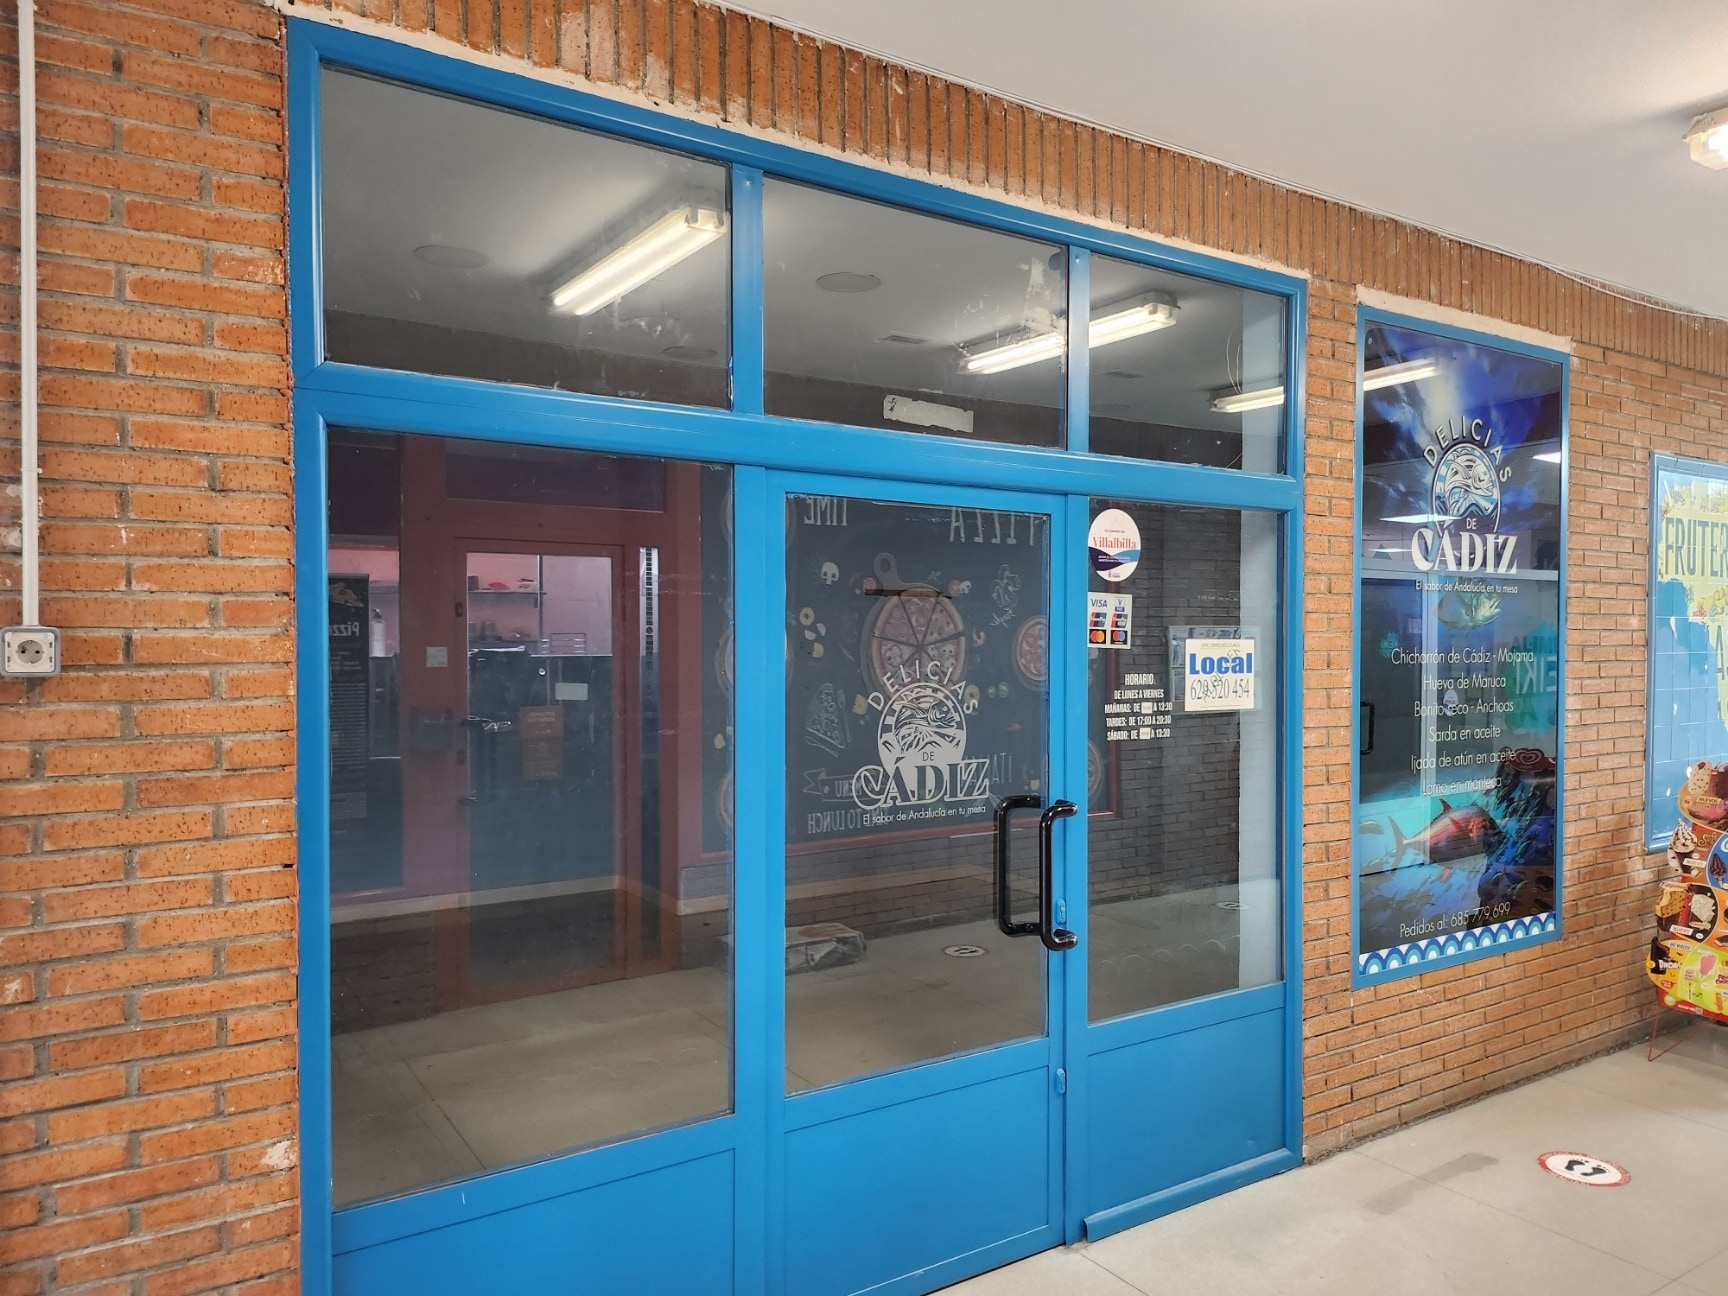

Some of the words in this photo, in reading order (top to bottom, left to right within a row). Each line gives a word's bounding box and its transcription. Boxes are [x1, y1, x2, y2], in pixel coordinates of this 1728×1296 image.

[1423, 415, 1512, 483] DELICIAS
[1466, 517, 1477, 530] DE
[1092, 536, 1137, 549] Villalbilla
[1411, 520, 1518, 575] CÁDIZ
[1424, 580, 1442, 591] sabor
[1444, 580, 1453, 591] de
[1454, 580, 1486, 592] Andalucía
[1486, 585, 1495, 593] en
[1502, 585, 1518, 593] mesa
[1090, 598, 1108, 608] VISA
[1188, 652, 1253, 675] Local
[1447, 649, 1460, 664] de
[1462, 647, 1491, 664] Cádiz
[1497, 648, 1534, 668] Mojama
[866, 659, 980, 715] DELICIAS
[1124, 673, 1154, 686] HORARIO
[1232, 678, 1250, 699] 454
[1423, 676, 1454, 690] Hueva
[1457, 673, 1469, 688] de
[1471, 675, 1506, 690] Maruca
[1133, 702, 1141, 713] DE
[1153, 702, 1158, 712] A
[1414, 700, 1444, 717] Bonito
[1476, 698, 1514, 714] Anchoas
[1128, 716, 1136, 726] DE
[1152, 715, 1156, 725] A
[1130, 729, 1138, 740] DE
[1151, 728, 1155, 739] A
[1428, 724, 1456, 743] Sarda
[1459, 730, 1471, 740] en
[1473, 726, 1501, 740] aceite
[922, 751, 935, 763] DE
[1438, 751, 1451, 767] de
[1454, 751, 1473, 766] atún
[1476, 753, 1487, 764] en
[1489, 749, 1517, 764] aceite
[852, 755, 990, 810] CÁDIZ
[1450, 782, 1462, 793] en
[863, 815, 870, 825] El
[872, 812, 895, 824] sabor
[896, 810, 907, 821] de
[908, 806, 946, 820] Andalucía
[947, 808, 958, 816] en
[958, 806, 966, 815] tu
[967, 805, 986, 815] mesa
[1399, 918, 1435, 938] Pedidos
[1436, 914, 1448, 930] al:
[1450, 912, 1470, 928] 685
[1471, 905, 1490, 924] 779
[1492, 901, 1511, 919] 699
